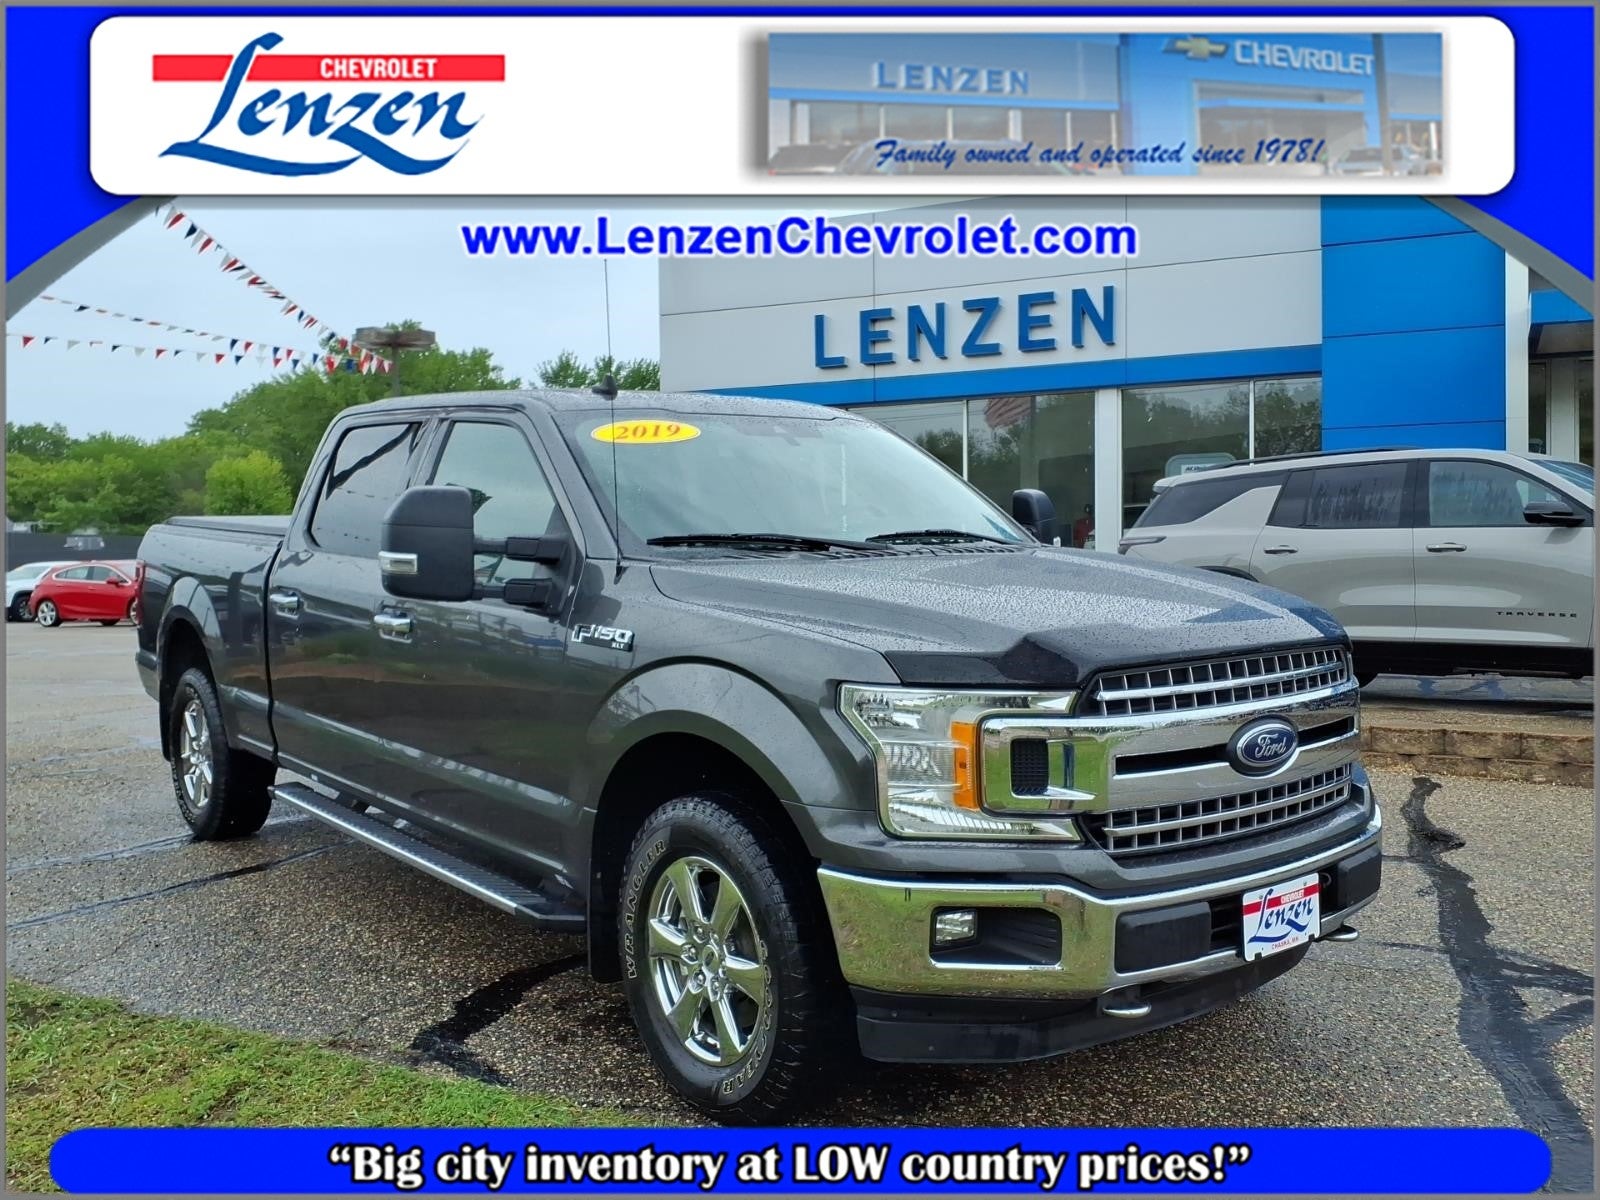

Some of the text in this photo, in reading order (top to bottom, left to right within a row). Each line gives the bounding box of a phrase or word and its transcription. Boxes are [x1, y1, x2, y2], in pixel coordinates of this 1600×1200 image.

[814, 285, 1117, 369] LENZEN
[615, 423, 681, 440] 2019
[1255, 733, 1287, 758] Ford
[624, 839, 666, 979] WRANGLER
[1247, 888, 1315, 944] Lenzen
